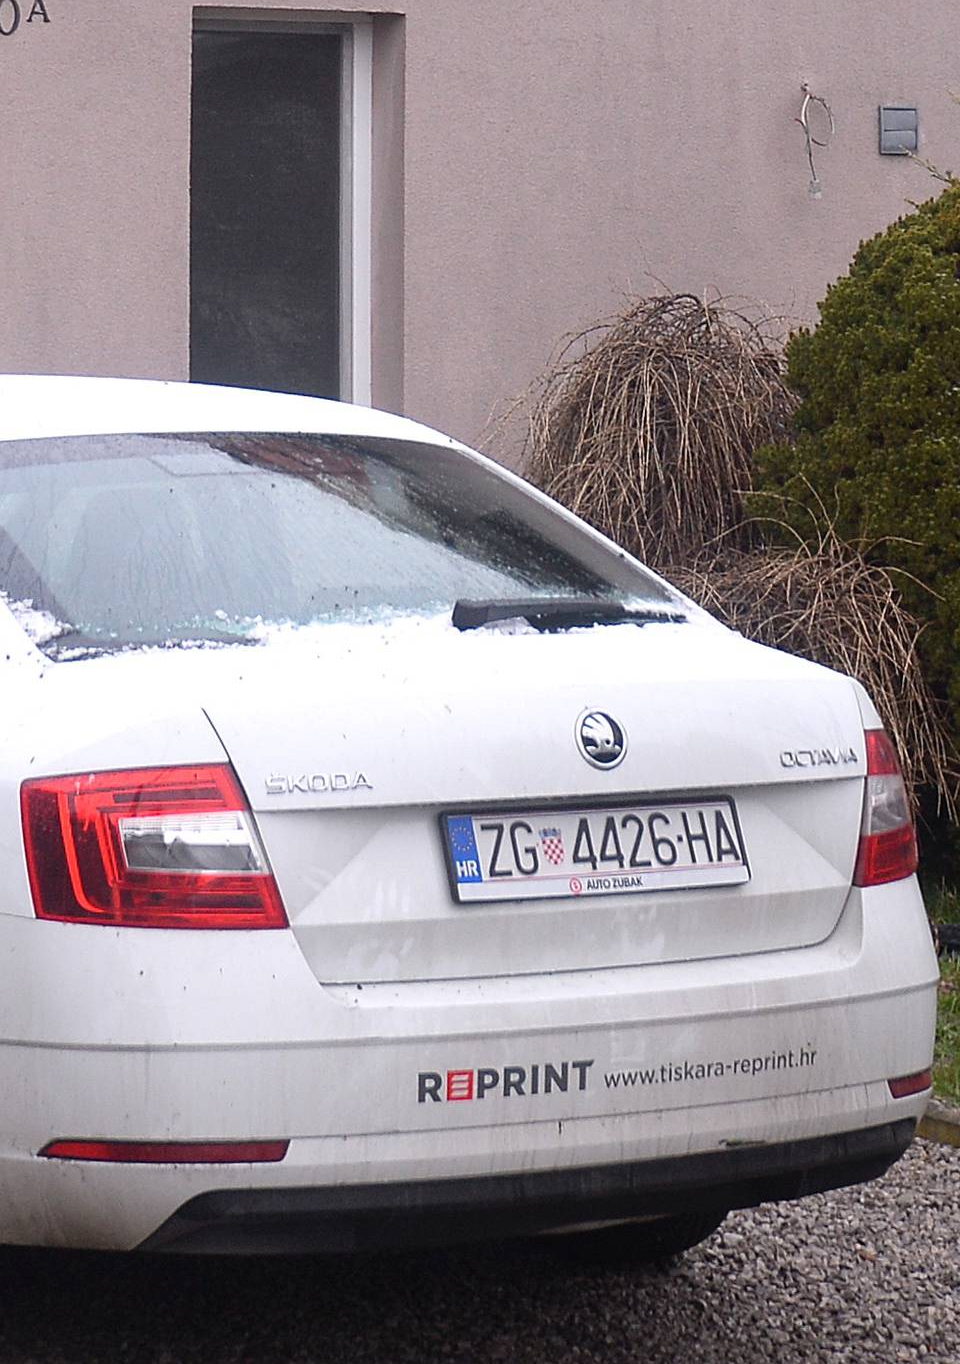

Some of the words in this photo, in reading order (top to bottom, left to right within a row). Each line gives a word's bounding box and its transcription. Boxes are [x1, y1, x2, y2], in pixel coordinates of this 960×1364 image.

[480, 820, 540, 877] ZG
[456, 859, 479, 877] HR
[586, 877, 611, 891] AUTO
[612, 875, 643, 889] ZUBAK
[417, 1061, 594, 1103] REPRINT
[604, 1046, 818, 1089] www.tiskara-reprint.hr
